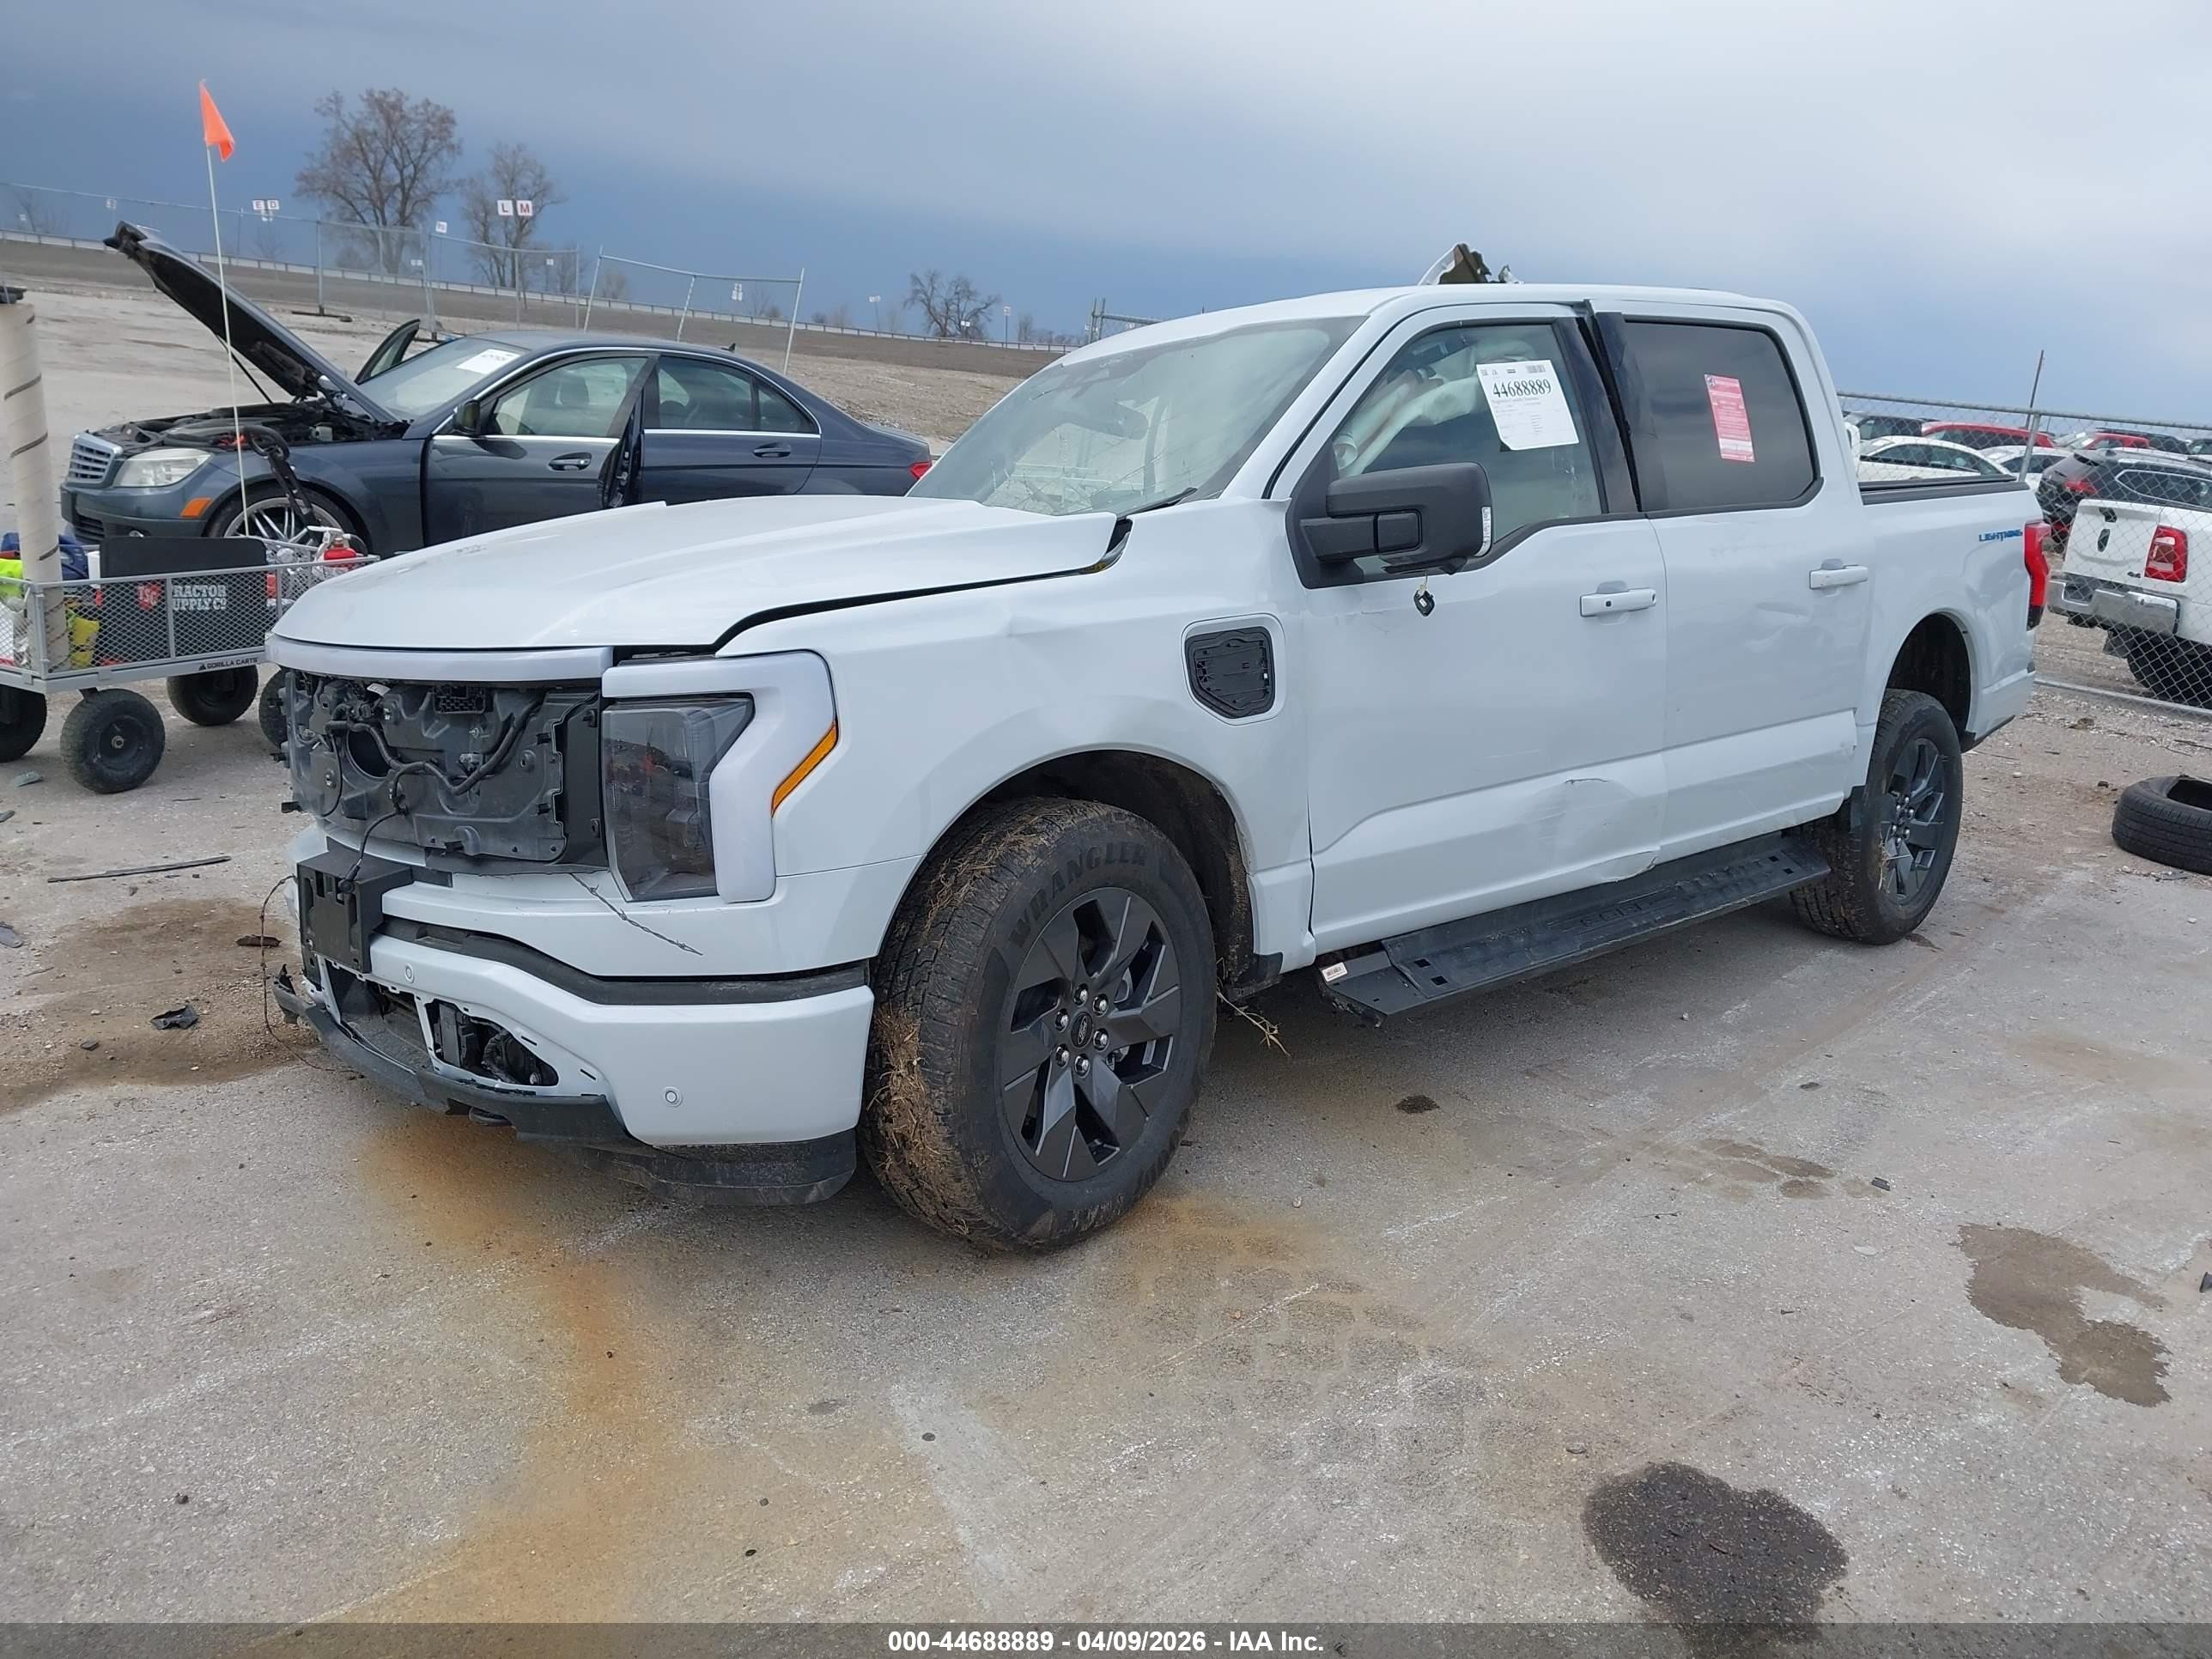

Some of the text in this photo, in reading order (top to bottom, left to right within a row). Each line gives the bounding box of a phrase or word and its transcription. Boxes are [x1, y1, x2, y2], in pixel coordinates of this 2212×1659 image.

[501, 203, 509, 213] L
[520, 203, 530, 214] M
[1492, 378, 1552, 398] 44688889
[172, 584, 227, 598] RACTOR
[172, 597, 212, 611] UPPLY
[206, 657, 258, 669] GORILLA CARTS
[1008, 841, 1147, 948] WRANGLER
